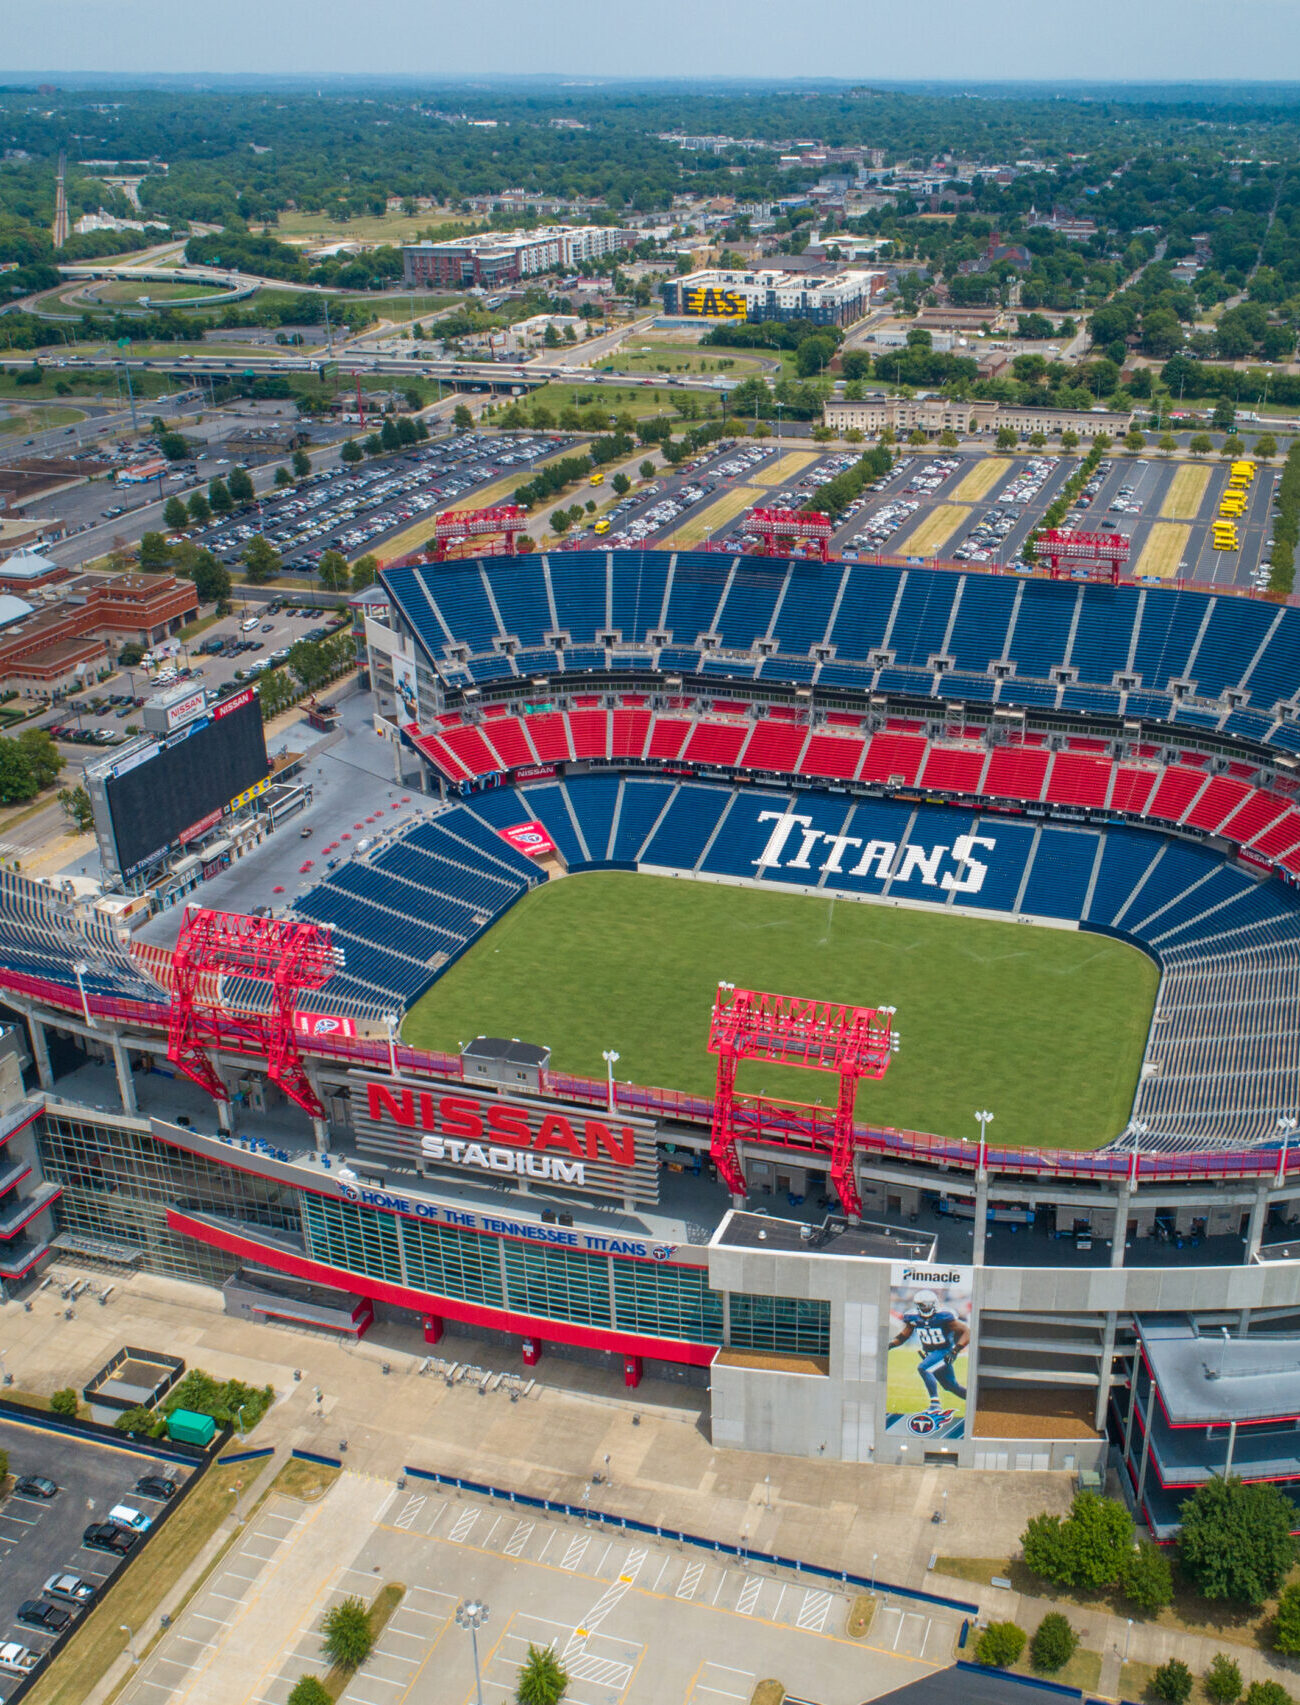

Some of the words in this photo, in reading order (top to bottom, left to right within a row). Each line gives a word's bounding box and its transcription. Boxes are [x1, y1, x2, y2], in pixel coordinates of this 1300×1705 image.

[170, 696, 203, 718] NISSAN
[219, 692, 250, 715] NISSAN
[517, 767, 554, 778] NISSAN
[751, 811, 997, 893] TITANS
[366, 1082, 636, 1166] NISSAN
[420, 1135, 586, 1186] STADIUM
[361, 1190, 411, 1213] HOME
[415, 1203, 438, 1218] OF
[443, 1209, 476, 1227] THE
[481, 1216, 578, 1247] TENNESSEE
[583, 1235, 647, 1257] TITANS
[903, 1269, 961, 1283] Pinnacle
